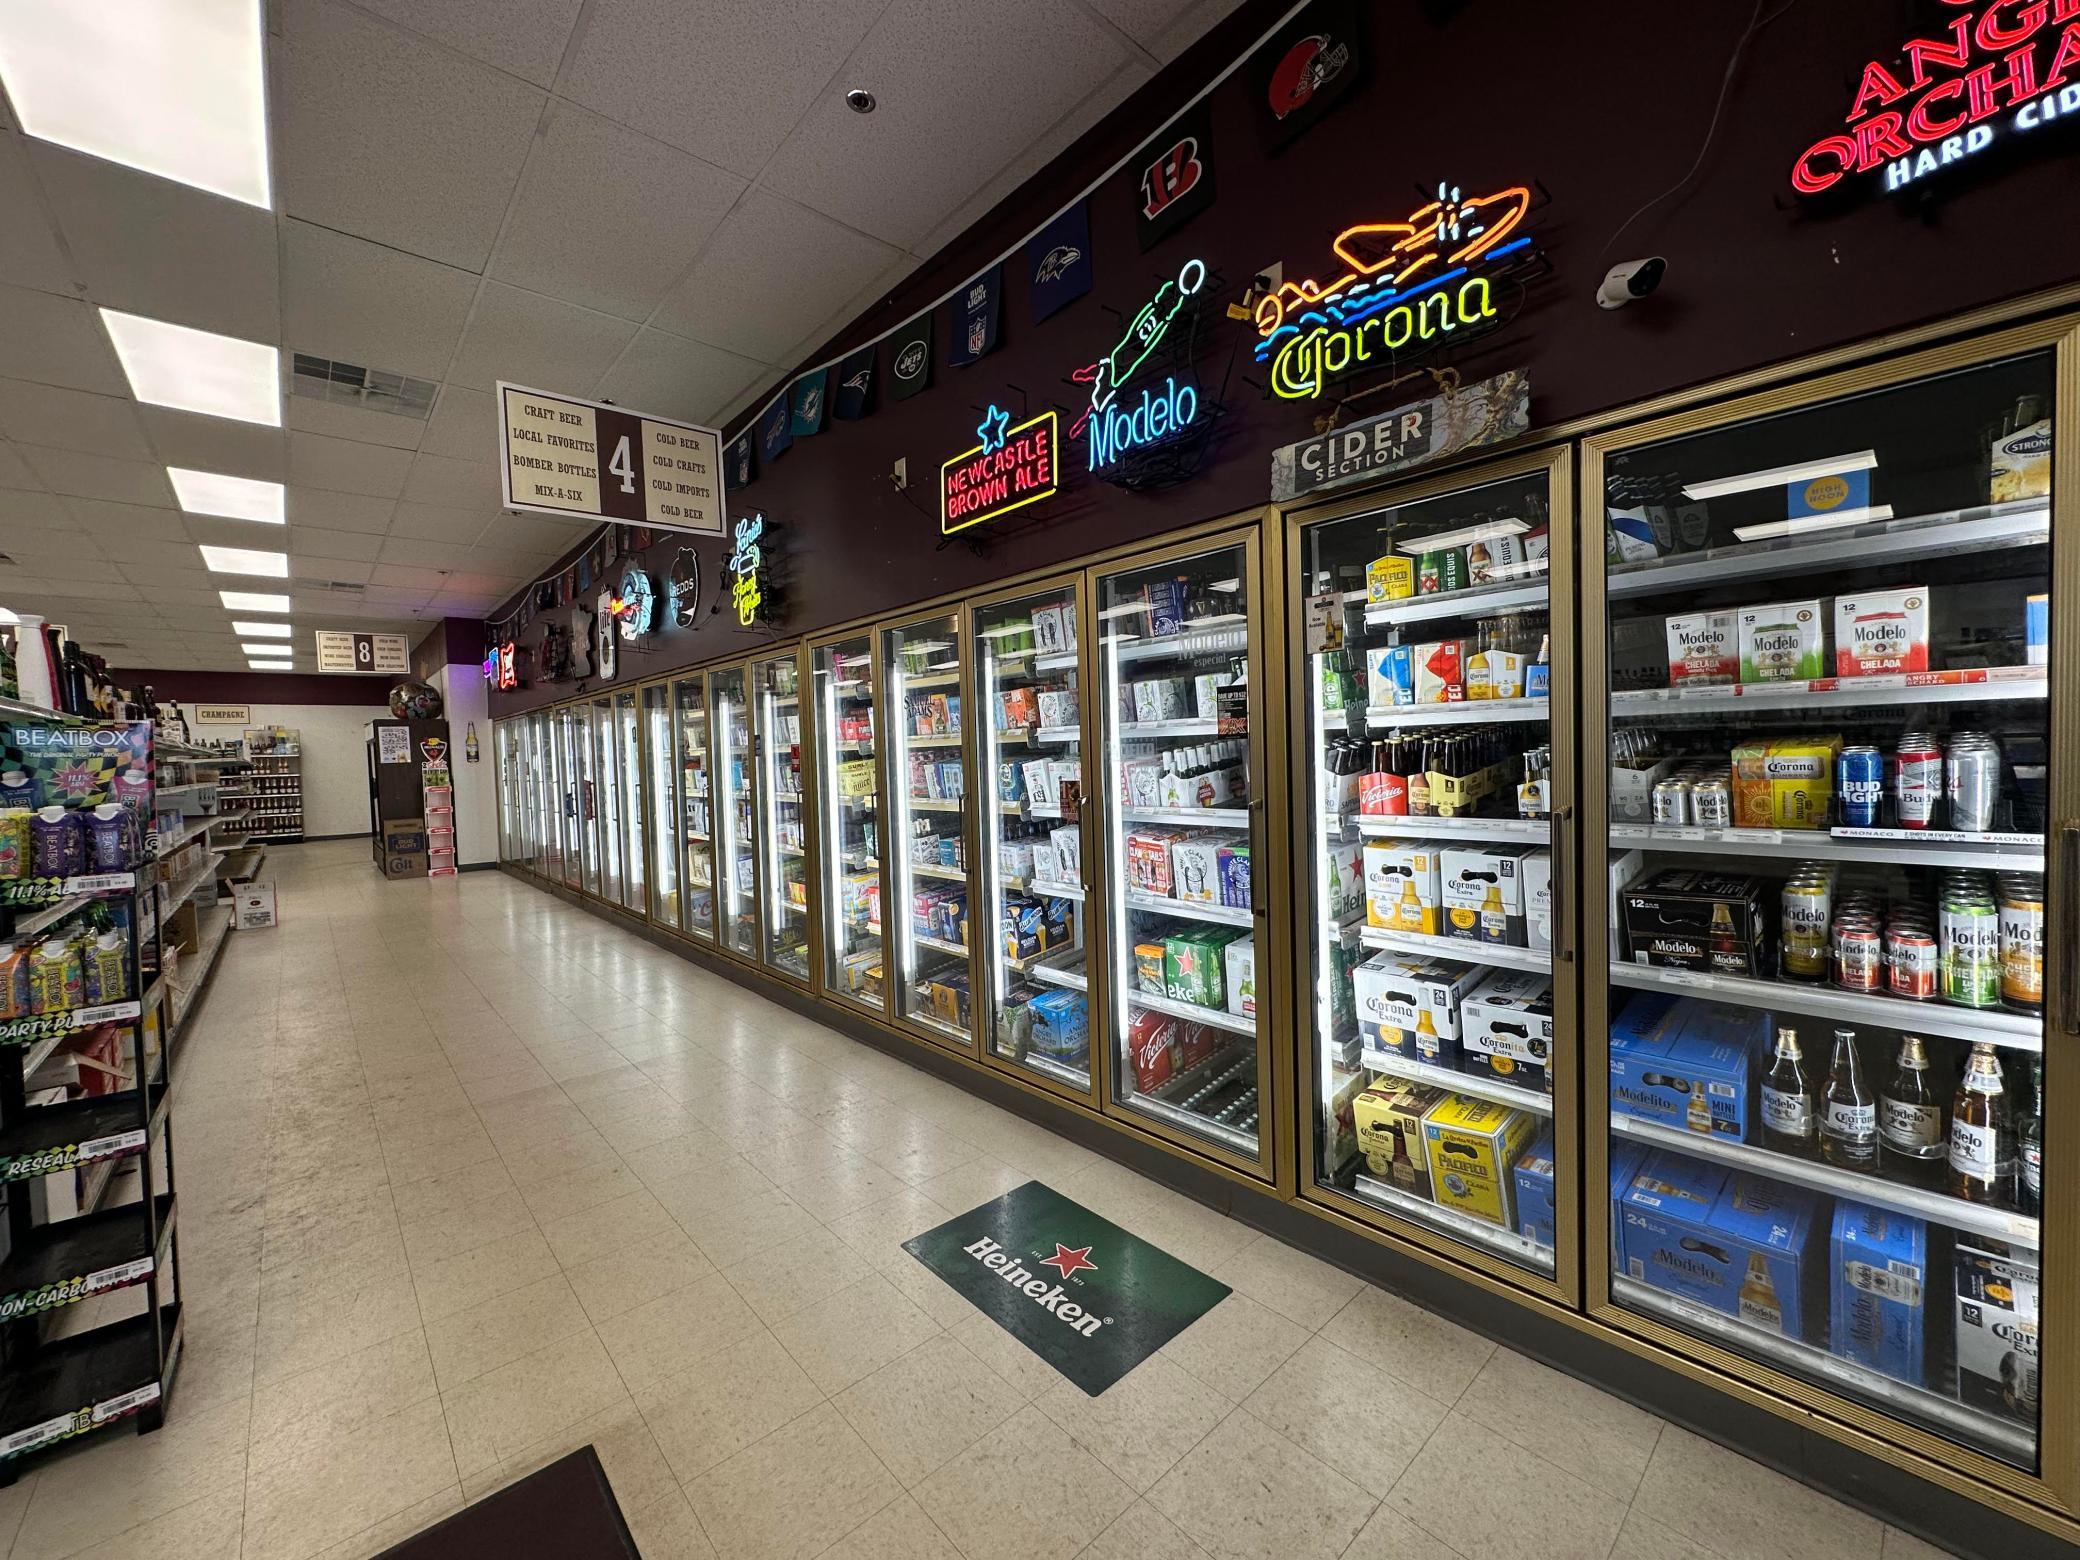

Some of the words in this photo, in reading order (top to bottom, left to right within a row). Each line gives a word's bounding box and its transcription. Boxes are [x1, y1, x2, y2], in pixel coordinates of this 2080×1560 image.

[1846, 0, 2080, 123] ANG
[1792, 22, 2080, 193] ORCHA
[1888, 125, 1993, 191] HARD
[2016, 83, 2080, 130] CID
[968, 290, 987, 309] LIGHT
[969, 284, 984, 299] BUD
[971, 329, 985, 351] NFL
[1272, 278, 1496, 399] Corona
[901, 351, 922, 370] JETS
[524, 405, 555, 421] CRAFT
[559, 412, 583, 426] BEER
[1088, 378, 1197, 472] Modelo
[513, 428, 543, 443] LOCAL
[547, 435, 595, 453] FAVORITES
[656, 432, 676, 446] COLD
[680, 438, 700, 451] BEER
[1301, 410, 1423, 471] CIDER
[513, 455, 554, 471] BOMBER
[558, 463, 597, 478] BOTTLES
[608, 435, 635, 494] 4
[653, 455, 673, 469] COLD
[676, 460, 706, 475] CRAFTS
[948, 430, 1047, 495] NEWCASTLE
[1315, 444, 1404, 481] SECTION
[535, 485, 583, 501] MIX-A-SIX
[652, 479, 672, 492] COLD
[676, 483, 710, 498] IMPORTS
[949, 478, 1008, 518] BROWN
[1016, 458, 1050, 492] ALE
[661, 504, 681, 516] COLD
[684, 508, 704, 520] BEER
[1501, 542, 1512, 565] EQUIS
[1447, 553, 1456, 575] EQUIS
[1680, 631, 1724, 645] Modelo
[1855, 625, 1906, 641] Modelo
[359, 641, 371, 662] 8
[1754, 636, 1798, 651] Modelo
[1194, 654, 1226, 667] especial
[1685, 660, 1720, 670] CHELADA
[1861, 660, 1900, 669] CHELADA
[1760, 667, 1795, 677] CHELADA
[201, 710, 245, 719] CHAMPAGNE
[1344, 699, 1369, 712] Heine
[15, 729, 130, 746] BEATBOX
[1767, 762, 1814, 772] Corona
[1361, 782, 1403, 807] Victoria
[1842, 781, 1881, 792] BUD
[1793, 790, 1805, 820] Corona
[46, 834, 59, 869] BEATBOX
[103, 831, 118, 865] BEATBOX
[1370, 873, 1400, 884] Corona
[1448, 879, 1481, 890] Corona
[10, 885, 47, 899] 11.1%
[1630, 899, 1645, 908] 12
[1654, 939, 1696, 954] Modelo
[1713, 954, 1743, 965] Modelo
[1435, 990, 1444, 998] 24
[1366, 996, 1413, 1018] Corona
[1379, 1011, 1402, 1024] Extra
[0, 1020, 52, 1039] PARTY
[1140, 1020, 1177, 1069] Victoria
[1480, 1036, 1525, 1052] Coronita
[1493, 1047, 1512, 1056] Extra
[1618, 1085, 1671, 1109] Modelito
[1713, 1100, 1735, 1113] MINI
[1886, 1103, 1925, 1123] Modelo
[1361, 1127, 1389, 1142] Corona
[1519, 1179, 1531, 1189] 12
[1627, 1213, 1648, 1228] 24
[1659, 1248, 1714, 1279] Modelo
[1965, 1307, 1979, 1318] 12
